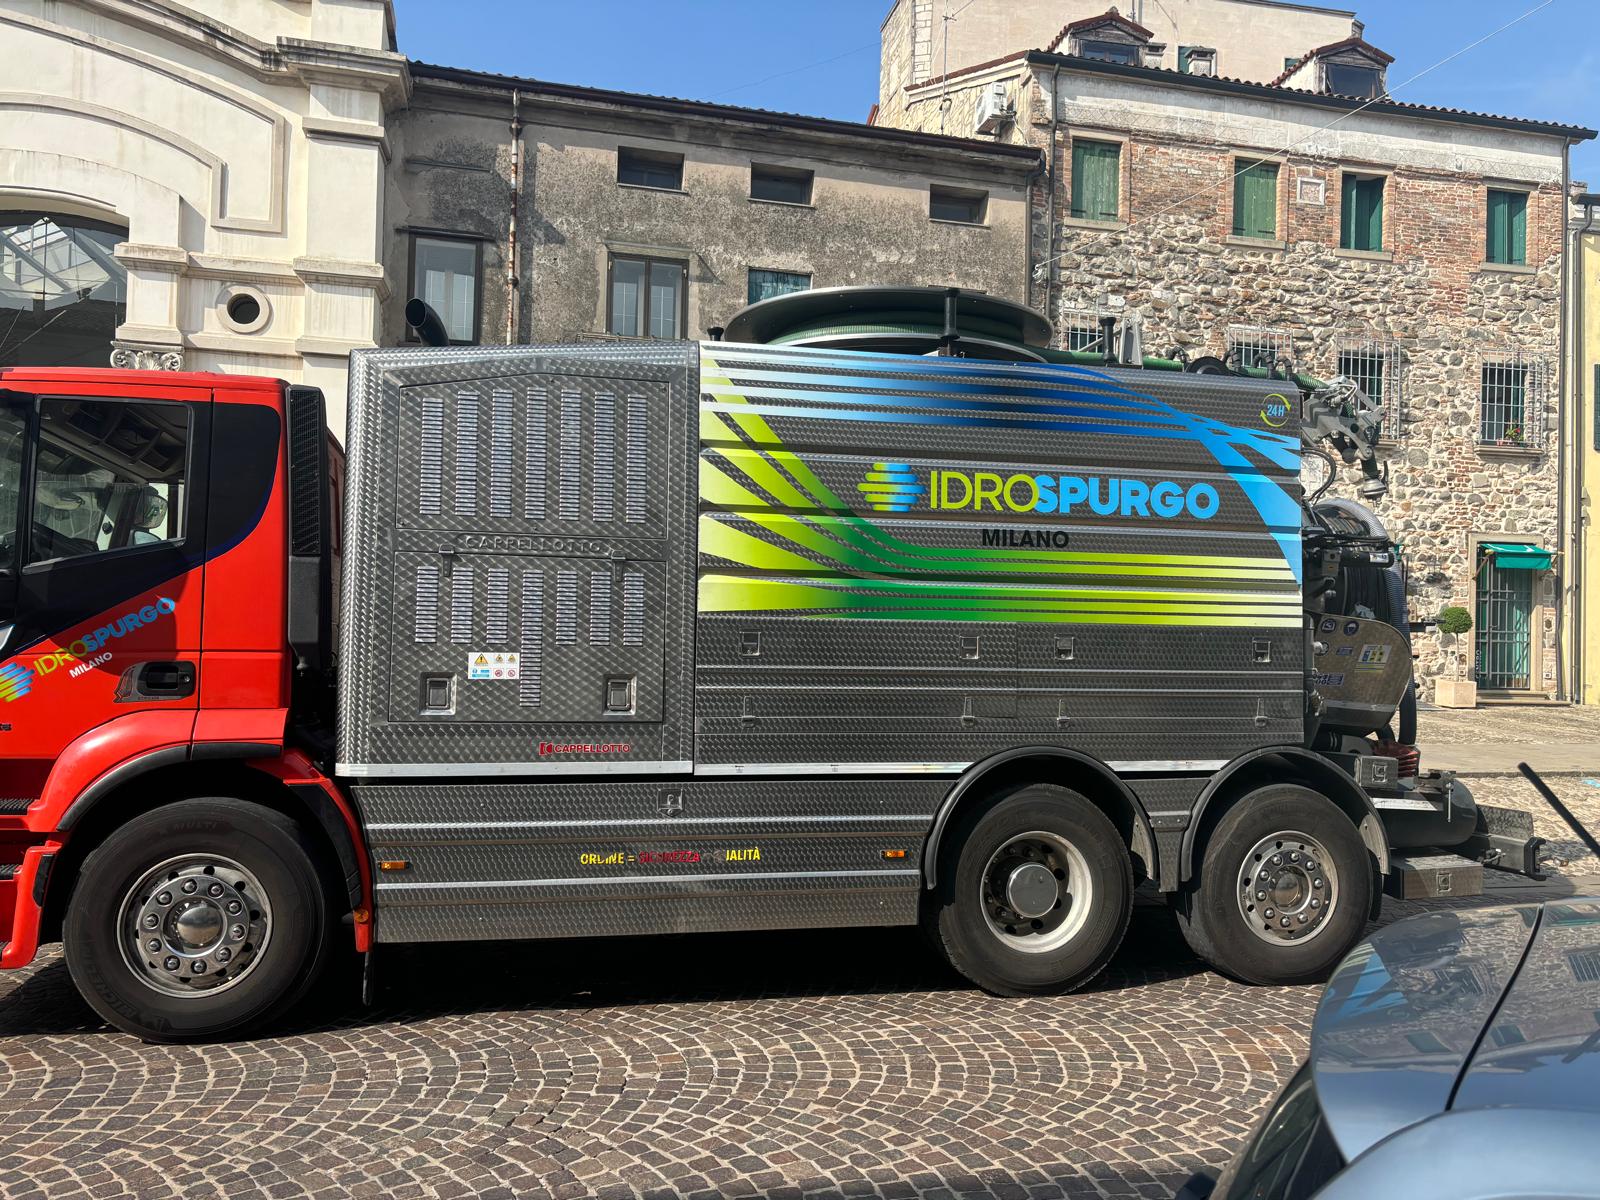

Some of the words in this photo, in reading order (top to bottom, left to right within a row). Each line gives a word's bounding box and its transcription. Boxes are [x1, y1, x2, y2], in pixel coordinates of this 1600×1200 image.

[1266, 403, 1285, 418] 24H
[930, 470, 1220, 520] IDROSPURGO
[981, 528, 1070, 549] MILANO
[33, 597, 176, 677] IDROSPURGO
[69, 651, 113, 678] MILANO
[554, 743, 631, 753] CAPPELLOTTO
